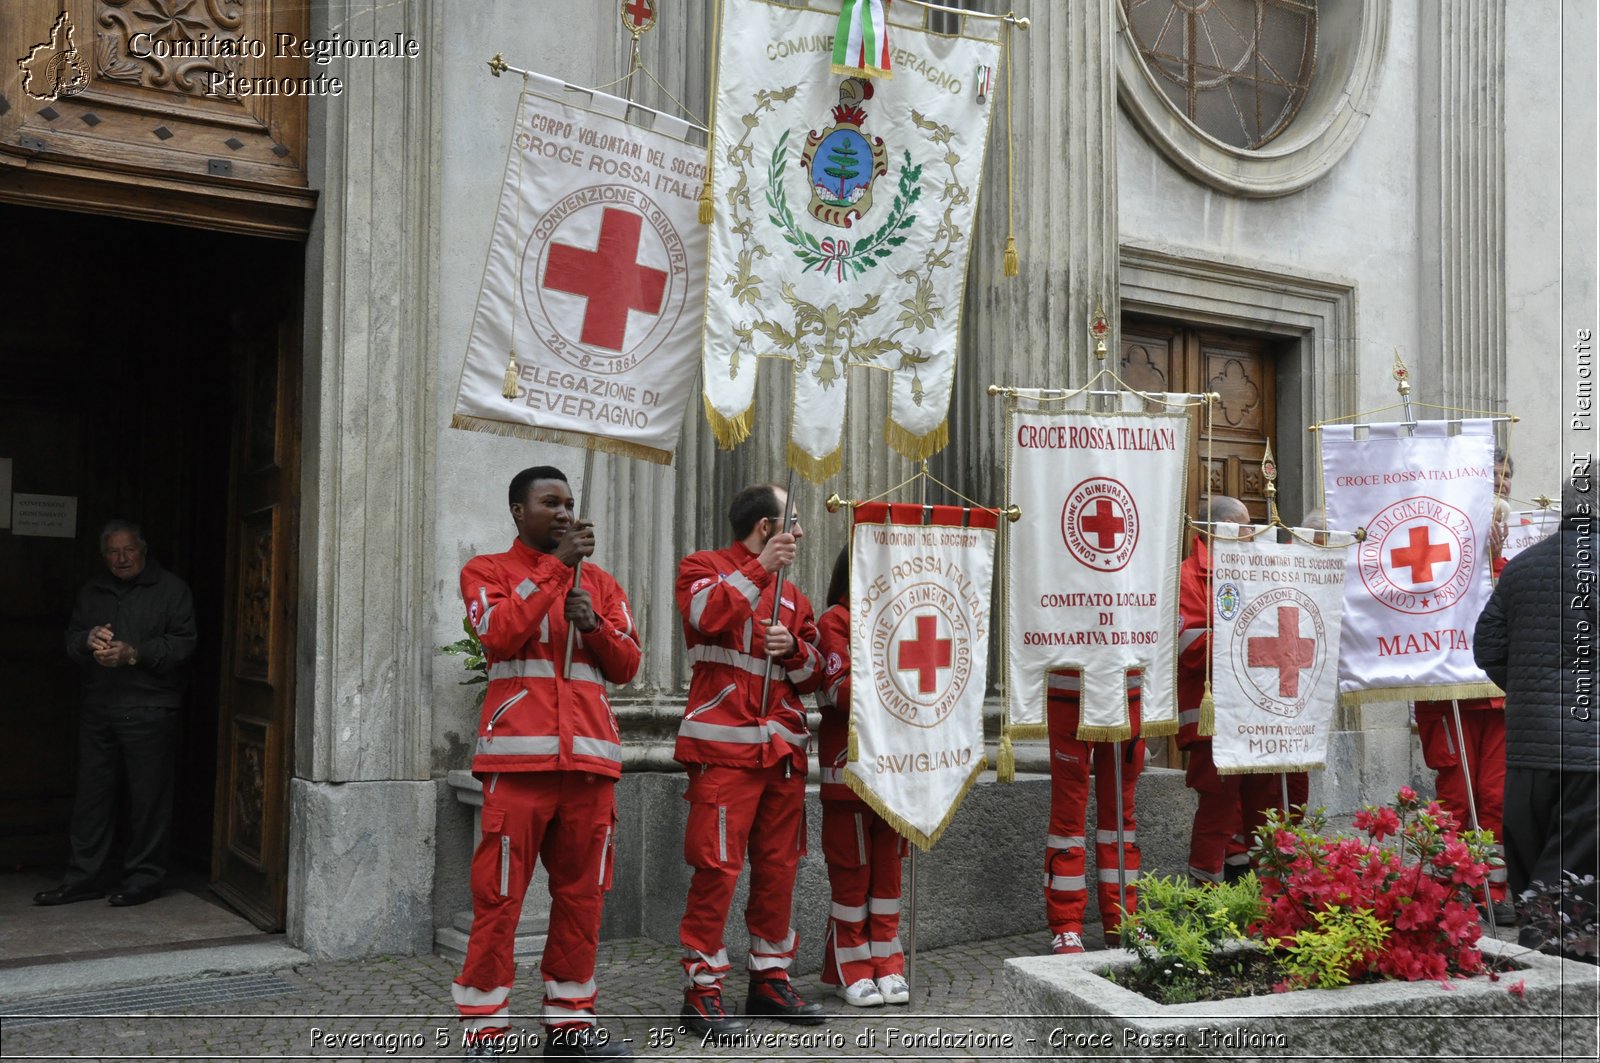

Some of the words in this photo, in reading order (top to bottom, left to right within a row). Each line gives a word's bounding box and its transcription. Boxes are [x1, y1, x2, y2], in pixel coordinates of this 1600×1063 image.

[767, 35, 835, 61] COMUNE
[531, 113, 572, 139] CORPO
[578, 127, 643, 160] VOLONTARI
[647, 150, 665, 170] DEL
[516, 133, 584, 167] CROCE
[589, 154, 650, 187] ROSSA
[655, 174, 704, 202] ITALI
[535, 187, 636, 241] CONVENZIONE
[639, 198, 649, 213] DI
[651, 211, 686, 276] GINEVRA
[642, 389, 660, 407] DI
[1018, 425, 1067, 449] CROCE
[1069, 426, 1115, 450] ROSSA
[1117, 427, 1175, 450] ITALIANA
[1336, 475, 1380, 487] CROCE
[1384, 470, 1426, 485] ROSSA
[1429, 466, 1488, 481] ITALIANA
[1075, 492, 1085, 503] DI
[1085, 484, 1121, 497] GINEVRA
[1121, 496, 1128, 506] 22
[1376, 516, 1394, 530] DI
[1393, 501, 1451, 524] GINEVRA
[1068, 502, 1096, 562] CONVENZIONE
[1452, 519, 1468, 535] 22
[921, 534, 937, 547] DEL
[1221, 553, 1246, 564] CORPO
[1294, 557, 1306, 568] DEL
[1364, 530, 1416, 609] CONVENZIONE
[1460, 534, 1473, 588] AGOSTO
[1216, 568, 1256, 582] CROCE
[1262, 570, 1300, 583] ROSSA
[1303, 572, 1344, 585] ITALIANA
[891, 556, 942, 583] ROSSA
[945, 562, 986, 642] ITALIANA
[1041, 593, 1113, 607] COMITATO
[1117, 593, 1157, 607] LOCALE
[1433, 583, 1459, 606] 1864
[893, 600, 907, 616] DI
[1099, 612, 1113, 626] DI
[1235, 589, 1293, 638] CONVENZIONE
[1295, 591, 1302, 601] DI
[1024, 631, 1108, 646] SOMMARIVA
[1111, 631, 1129, 645] DEL
[1376, 629, 1469, 657] MANTA
[873, 618, 918, 720] CONVENZIONE
[1249, 739, 1309, 753] MORETTA
[876, 748, 972, 774] SAVIGLIANO
